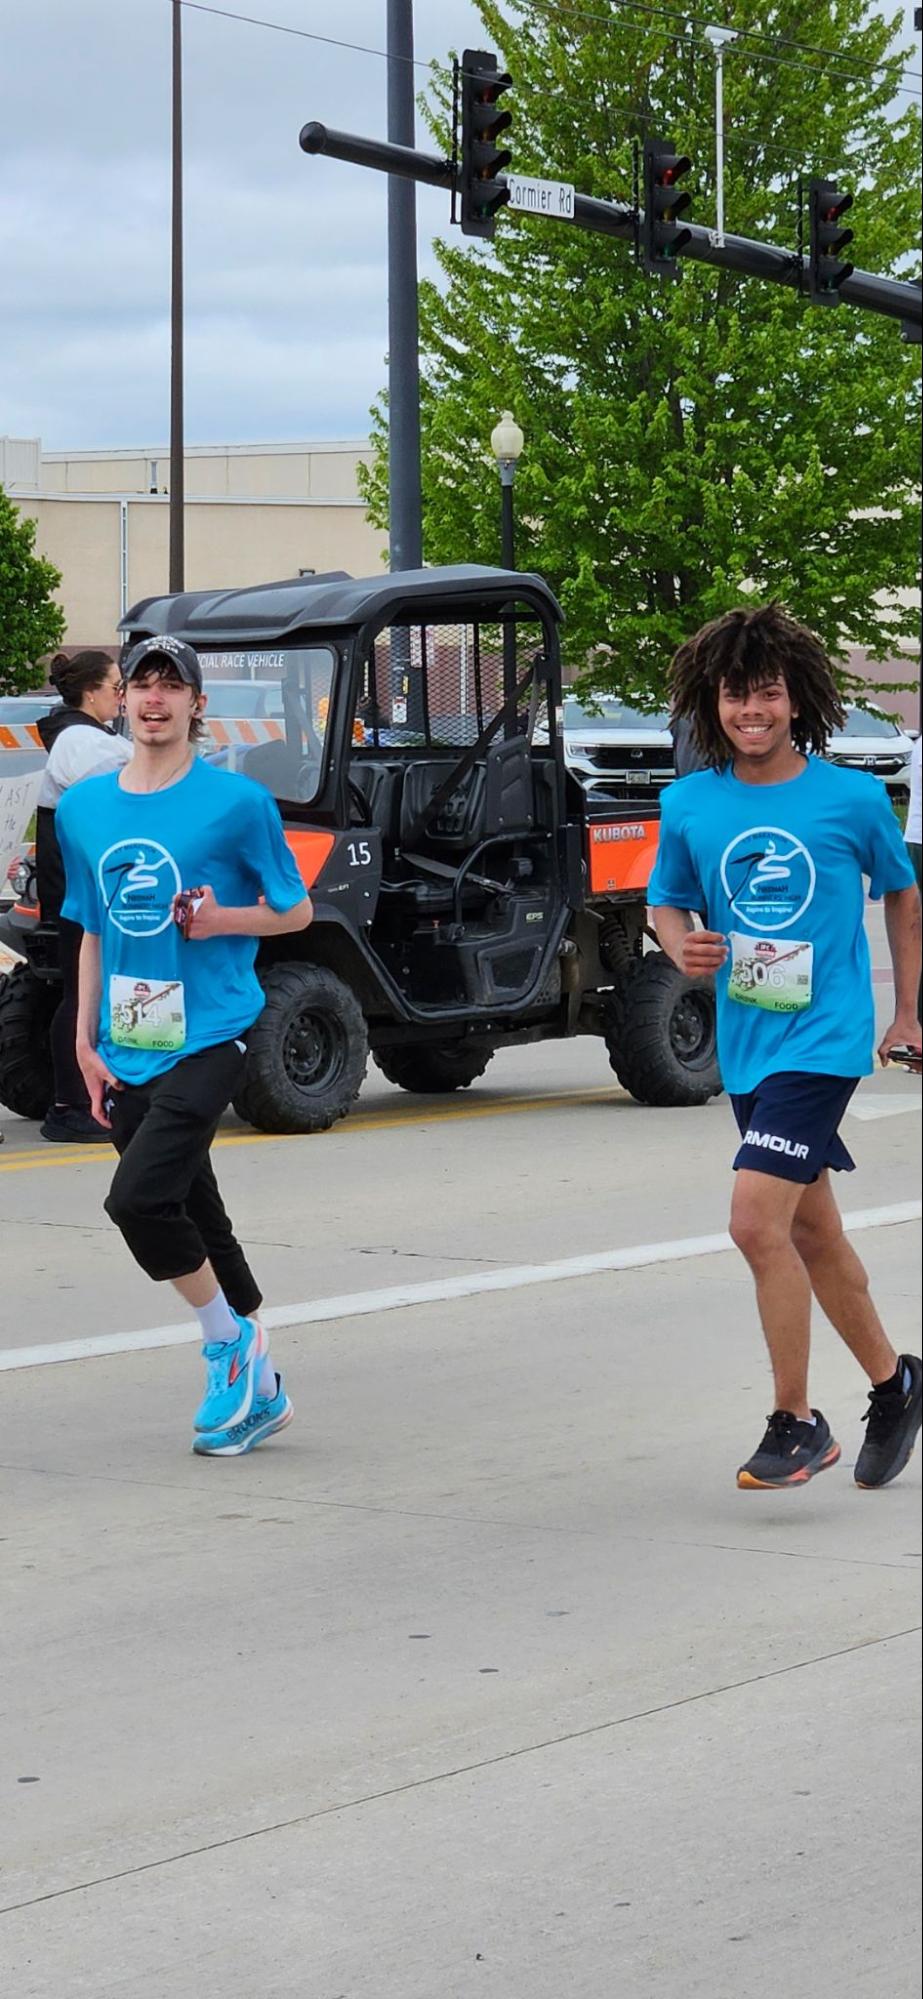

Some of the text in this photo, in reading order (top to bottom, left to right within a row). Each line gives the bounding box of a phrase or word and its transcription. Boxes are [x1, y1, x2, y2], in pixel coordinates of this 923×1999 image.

[509, 178, 572, 213] Cormier Rd
[220, 654, 246, 668] RACE
[247, 653, 285, 668] VEHICLE
[593, 825, 645, 842] KUBOTA
[347, 841, 372, 867] 15
[740, 959, 786, 990] 506
[120, 1000, 162, 1028] 514
[774, 1001, 799, 1010] FOOD
[151, 1040, 175, 1048] FOOD
[743, 1130, 810, 1160] RMOUR
[225, 1406, 271, 1441] BROOKS
